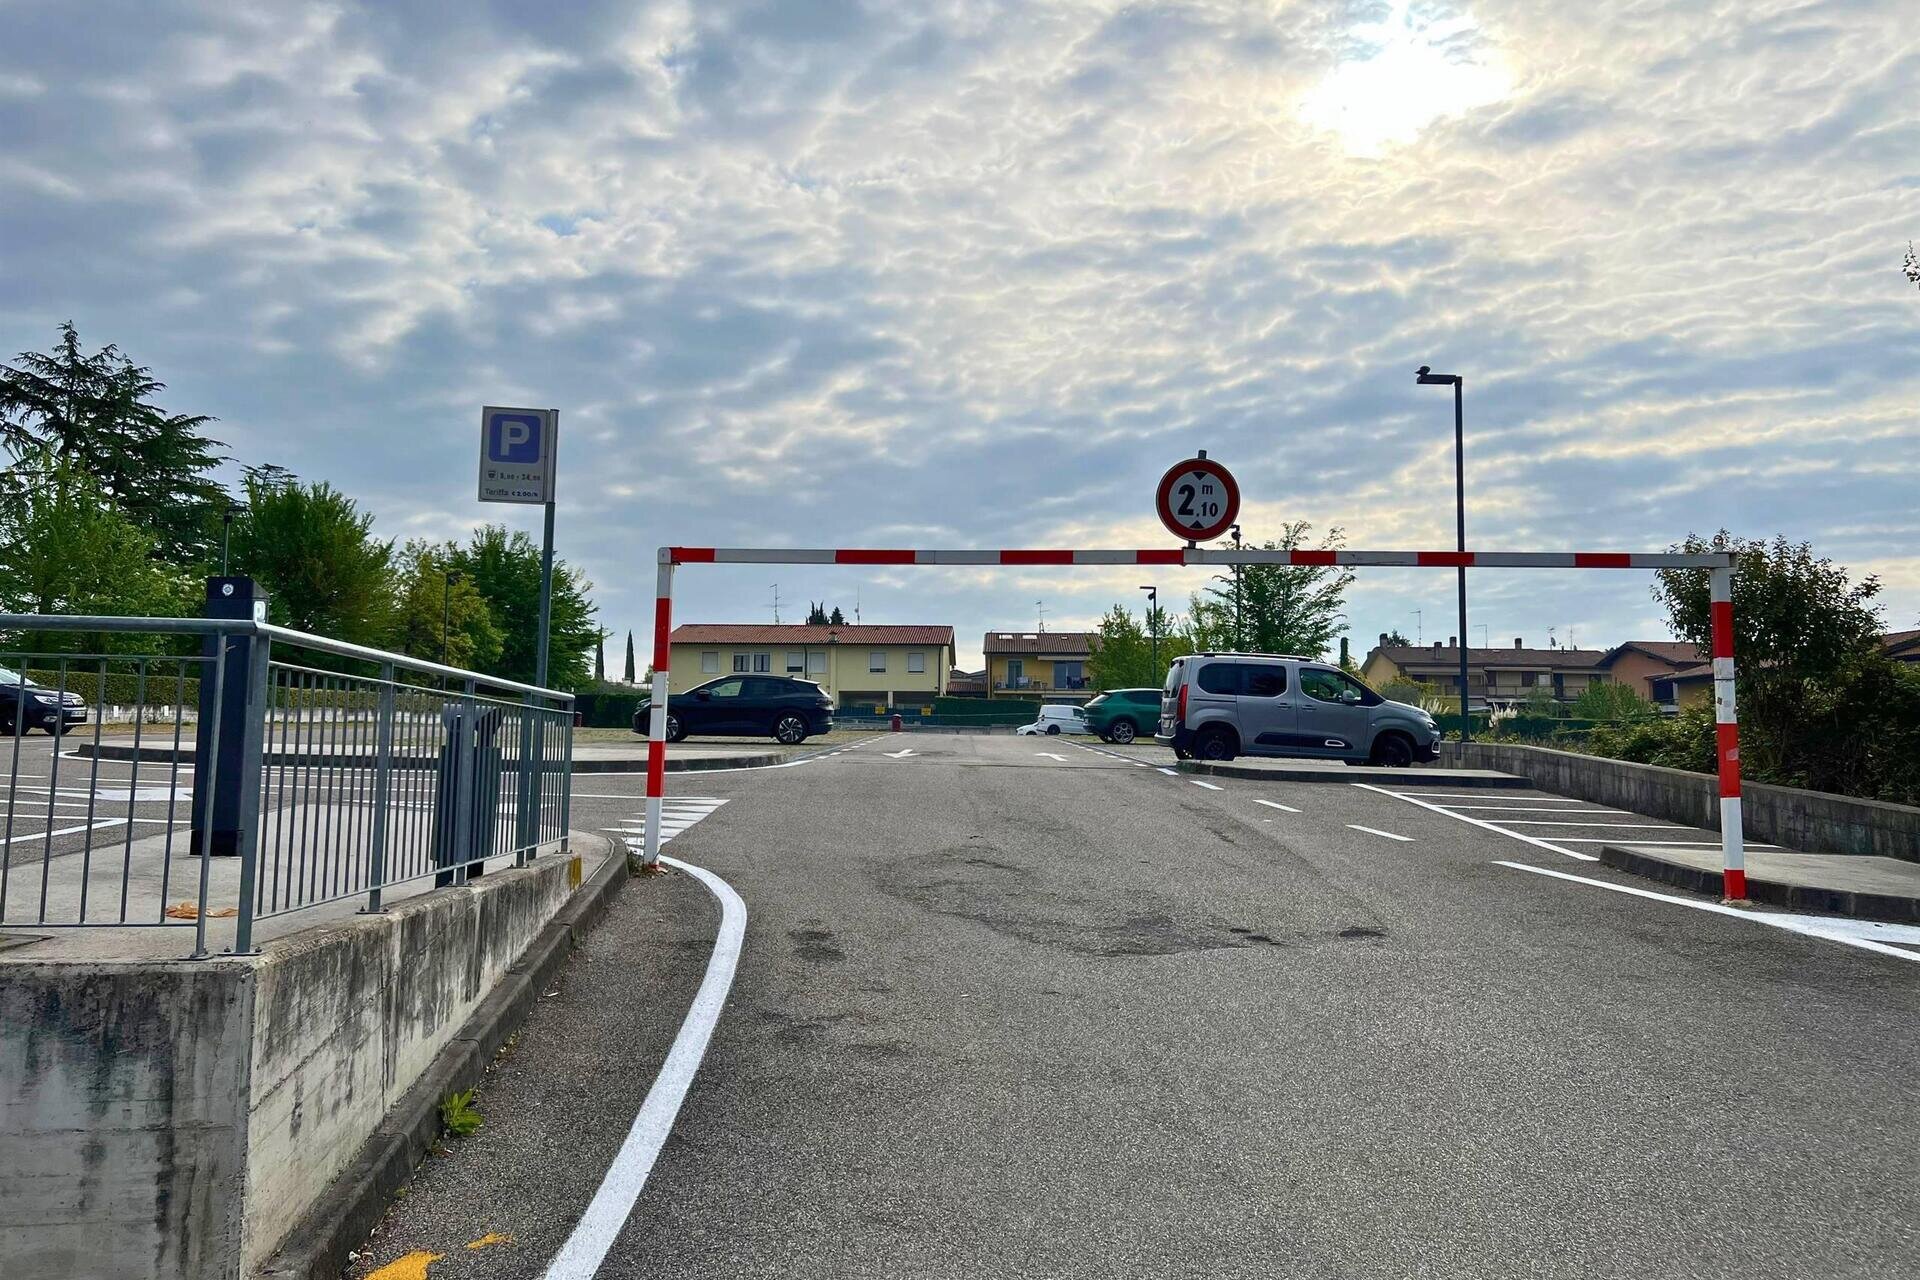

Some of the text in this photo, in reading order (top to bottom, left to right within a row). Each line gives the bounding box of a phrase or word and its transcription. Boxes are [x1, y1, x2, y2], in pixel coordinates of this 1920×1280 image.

[501, 421, 530, 456] P
[485, 488, 509, 496] Tariffa
[1202, 485, 1213, 495] m
